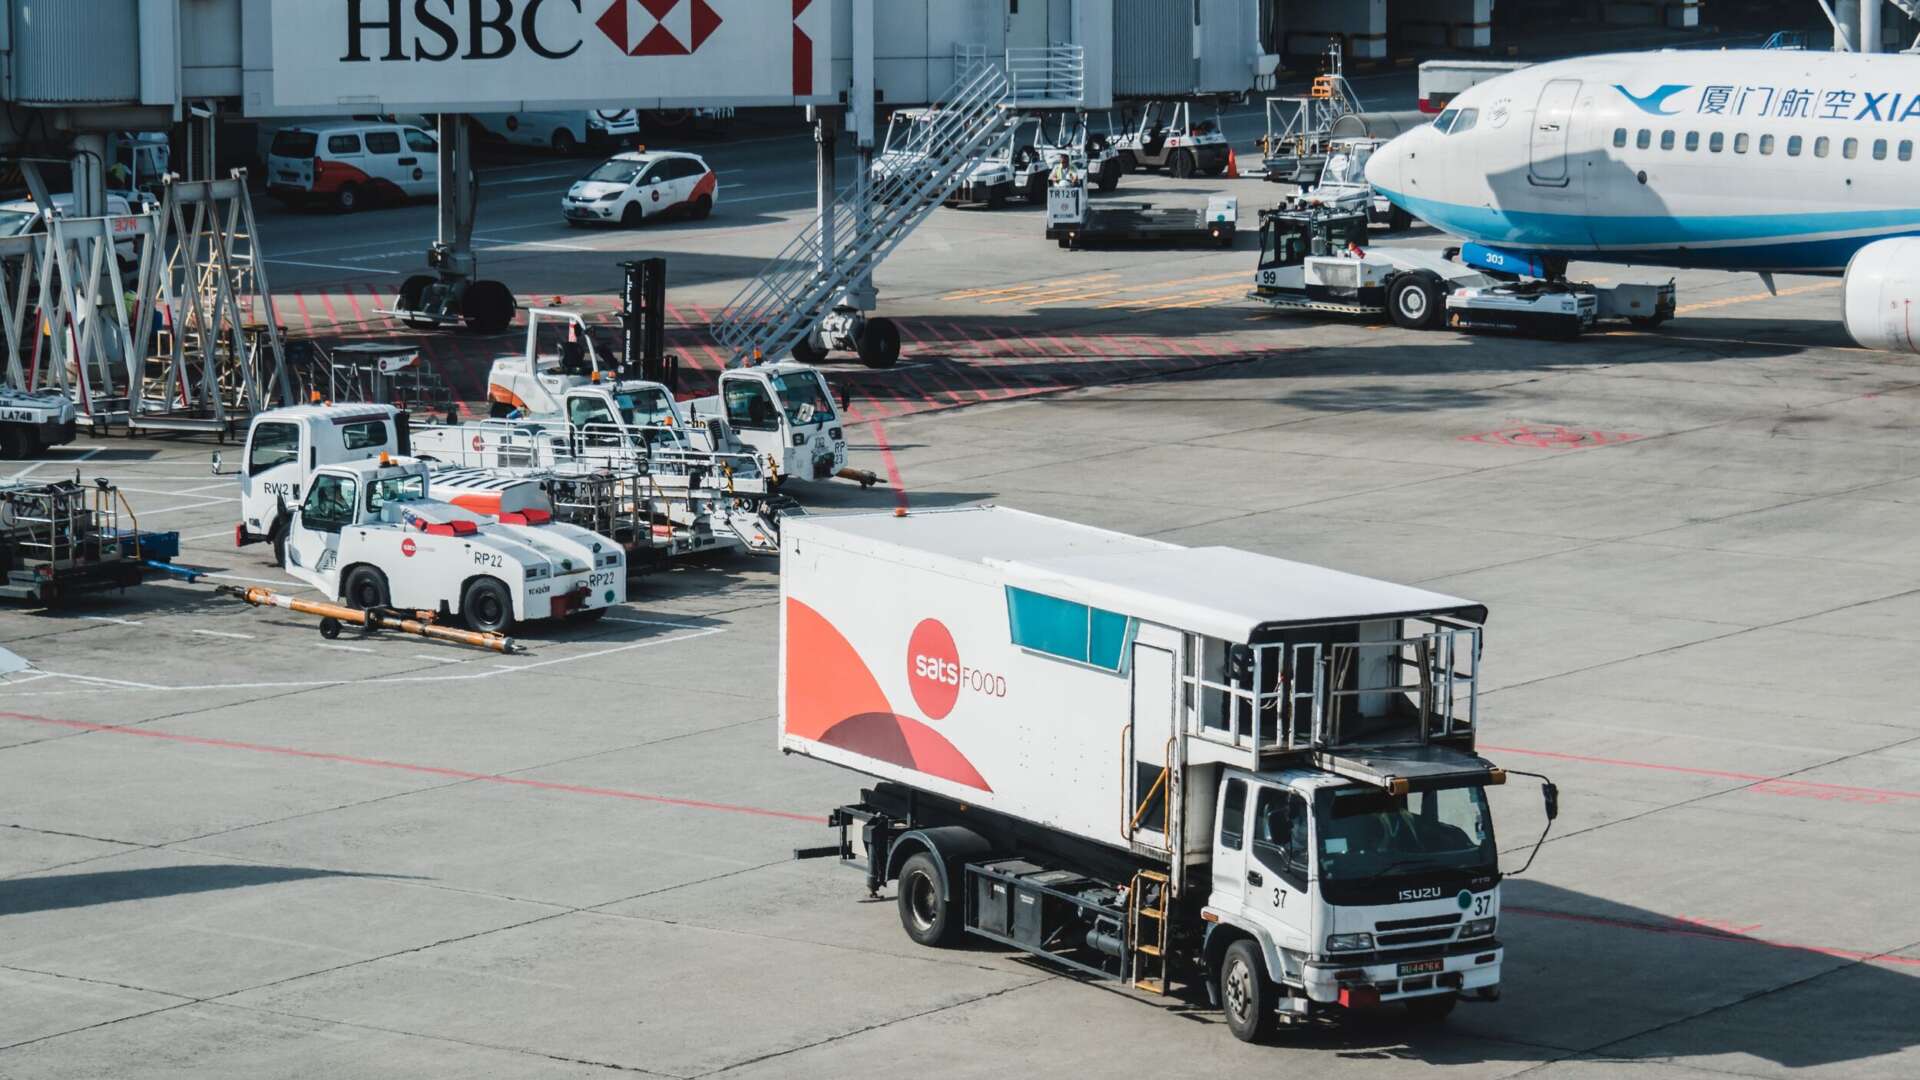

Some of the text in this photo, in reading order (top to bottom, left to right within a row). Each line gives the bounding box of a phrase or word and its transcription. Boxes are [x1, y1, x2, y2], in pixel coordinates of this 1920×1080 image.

[339, 0, 584, 62] HSBC
[1697, 85, 1856, 120] 厦门航空
[1486, 253, 1504, 265] 303
[1263, 271, 1276, 284] 99
[264, 482, 289, 495] RW2
[474, 552, 503, 567] RP22
[589, 572, 615, 587] RP22
[915, 654, 1007, 698] sats FOOD
[1273, 888, 1287, 908] 37
[1399, 886, 1441, 901] ISUZU
[1474, 895, 1491, 916] 37
